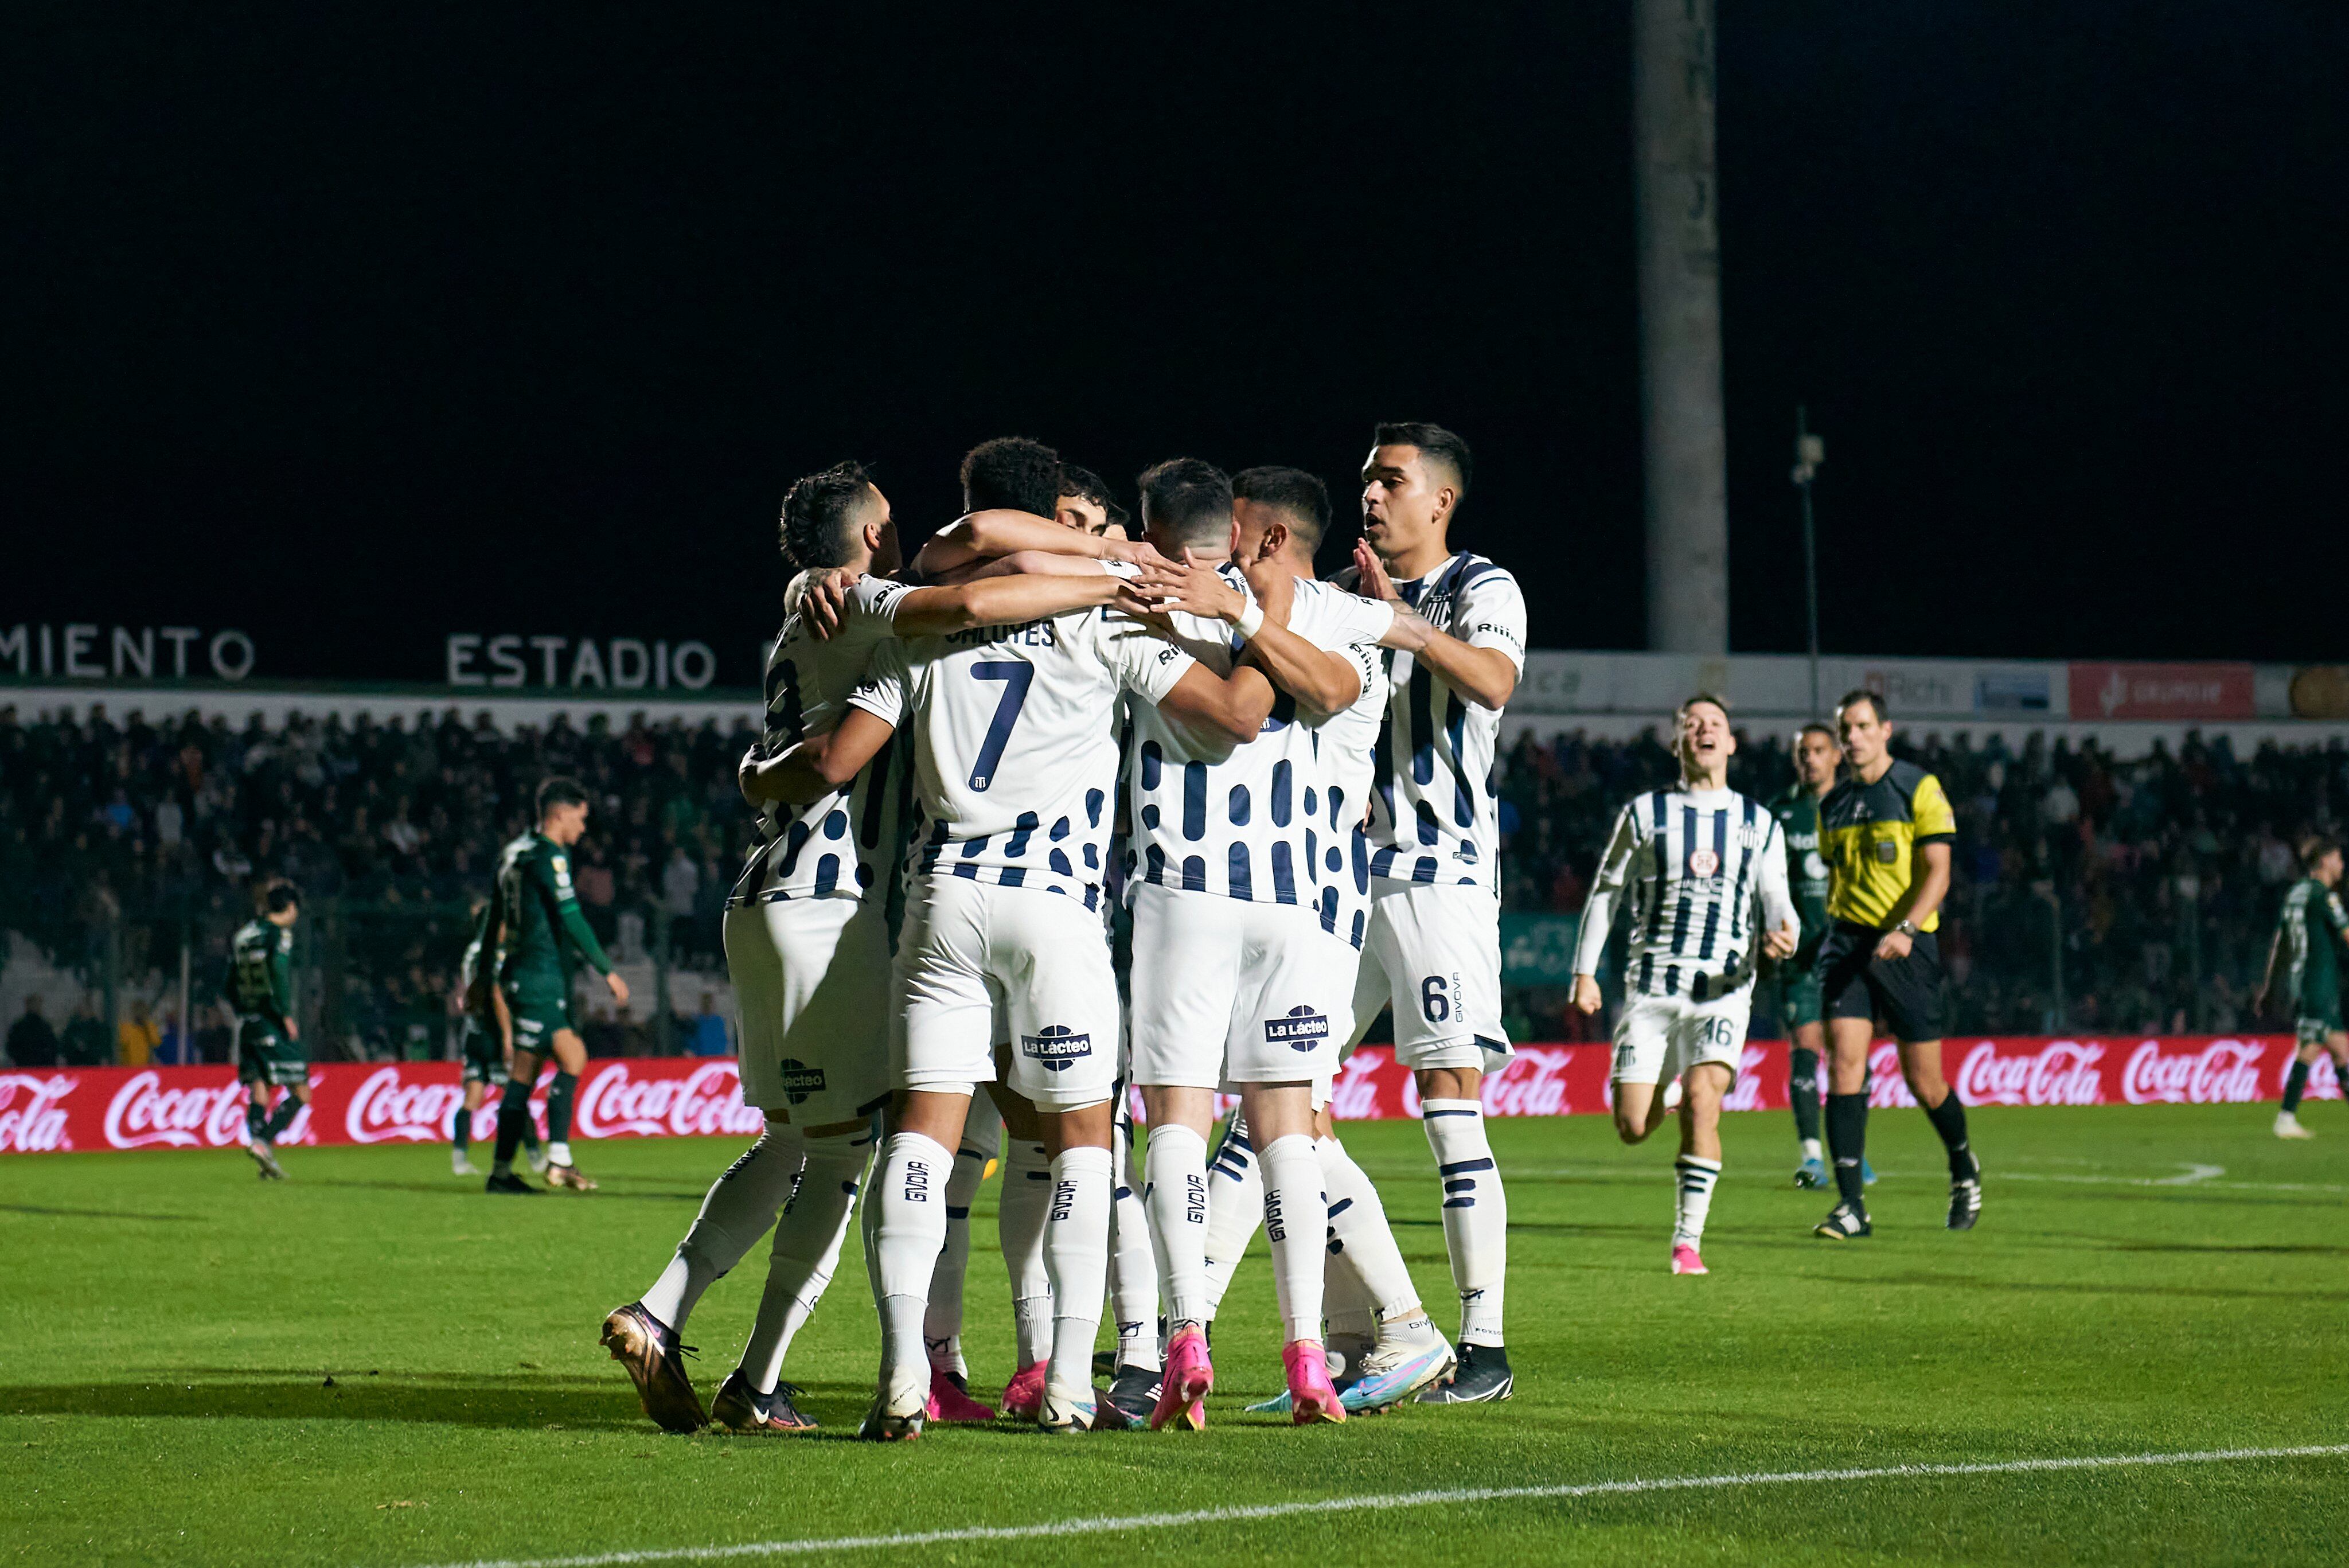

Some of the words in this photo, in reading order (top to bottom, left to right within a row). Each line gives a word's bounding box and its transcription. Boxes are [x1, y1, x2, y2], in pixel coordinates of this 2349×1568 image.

[446, 633, 717, 691] ESTADIO
[968, 661, 1035, 793] 7
[1422, 975, 1449, 1023] 6
[1451, 972, 1464, 1023] GIVOVA
[1024, 1041, 1039, 1054] La
[1040, 1039, 1089, 1055] Lácteo
[1269, 1025, 1287, 1037] La
[1288, 1020, 1327, 1036] Lácteo
[1705, 1016, 1734, 1047] 16
[904, 1161, 929, 1203] GIVOVA
[1050, 1179, 1078, 1222] GIVOVA
[1187, 1174, 1204, 1224] GIVOVA
[1265, 1189, 1286, 1243] GIVOVA
